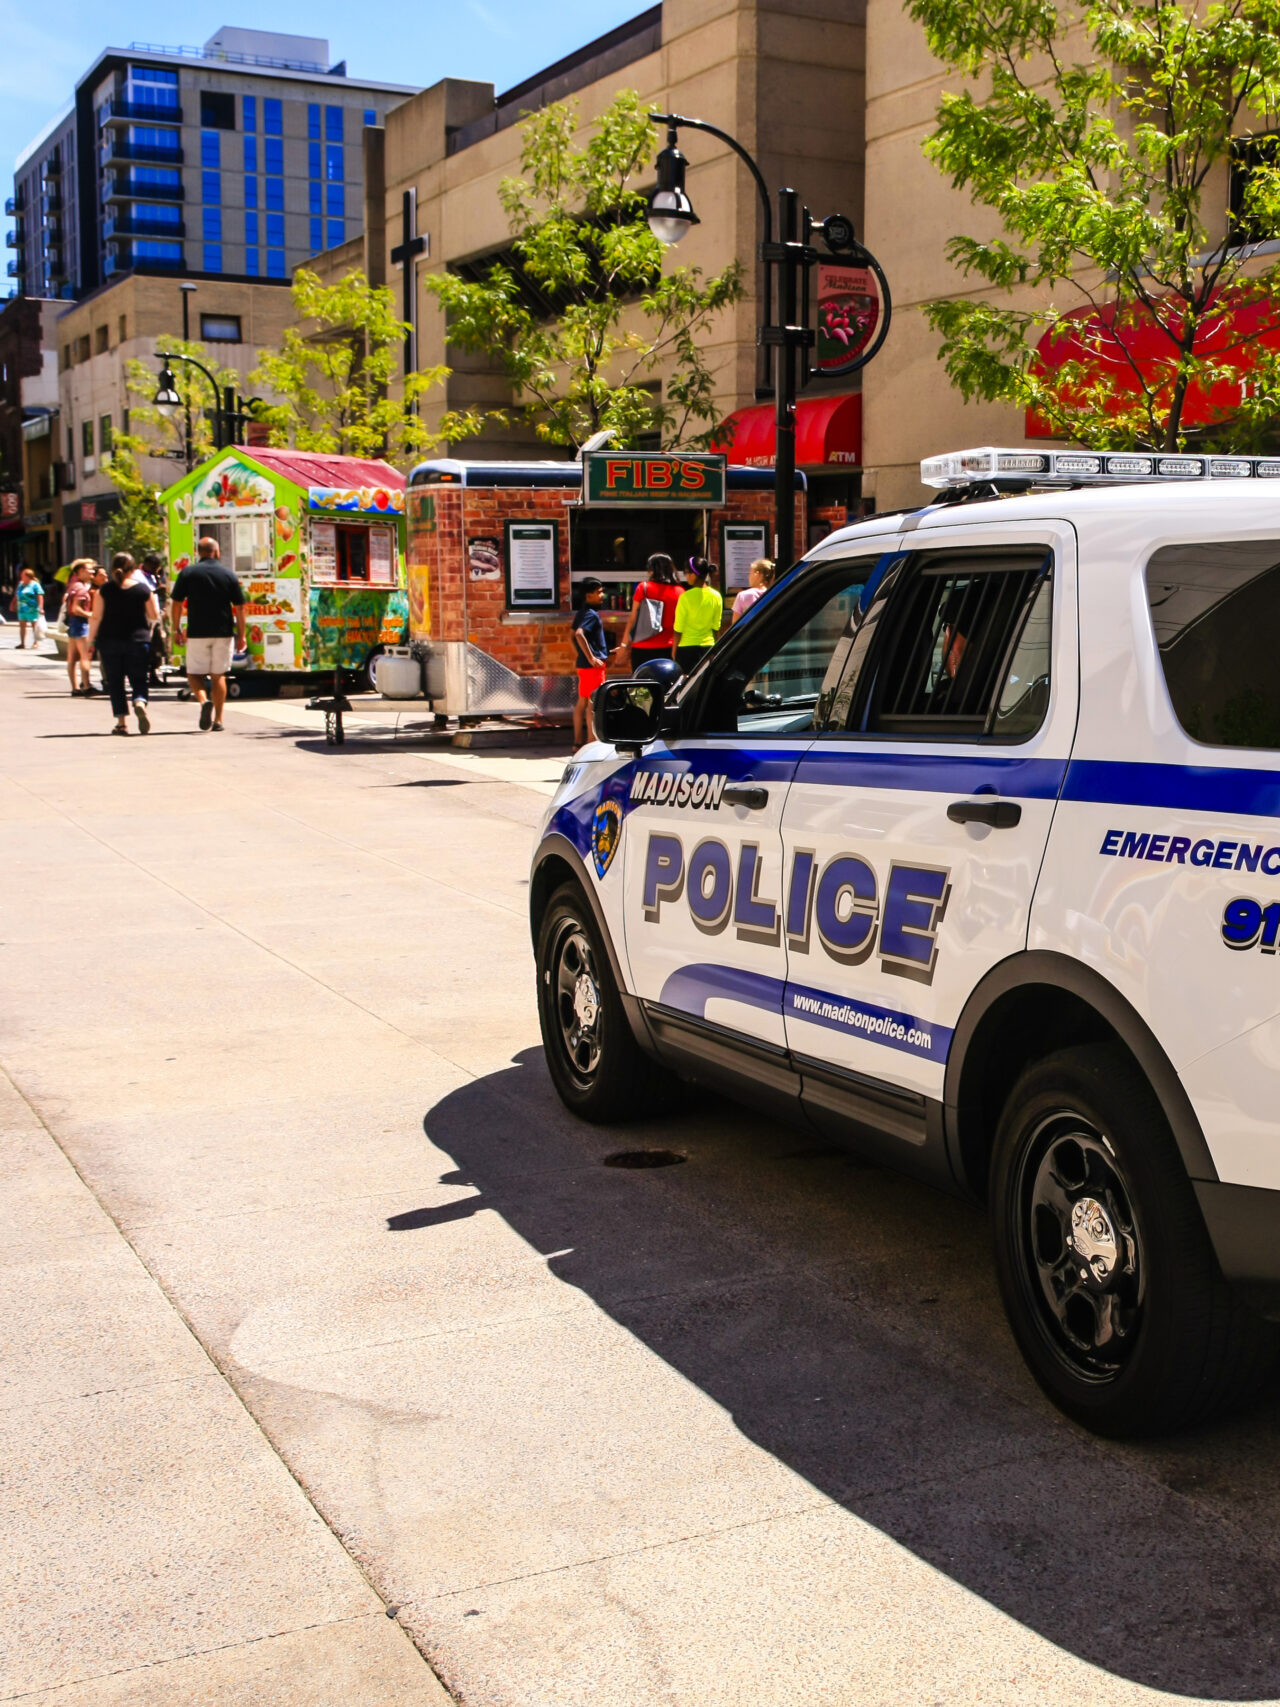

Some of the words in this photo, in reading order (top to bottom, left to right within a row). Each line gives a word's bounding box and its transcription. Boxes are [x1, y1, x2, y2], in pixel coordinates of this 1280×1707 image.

[605, 459, 706, 489] FIB'S
[828, 451, 856, 463] ATM
[248, 582, 275, 593] JUICE
[630, 771, 727, 810] MADISON
[642, 831, 952, 986] POLICE
[793, 994, 932, 1049] www.madisonpolice.com
